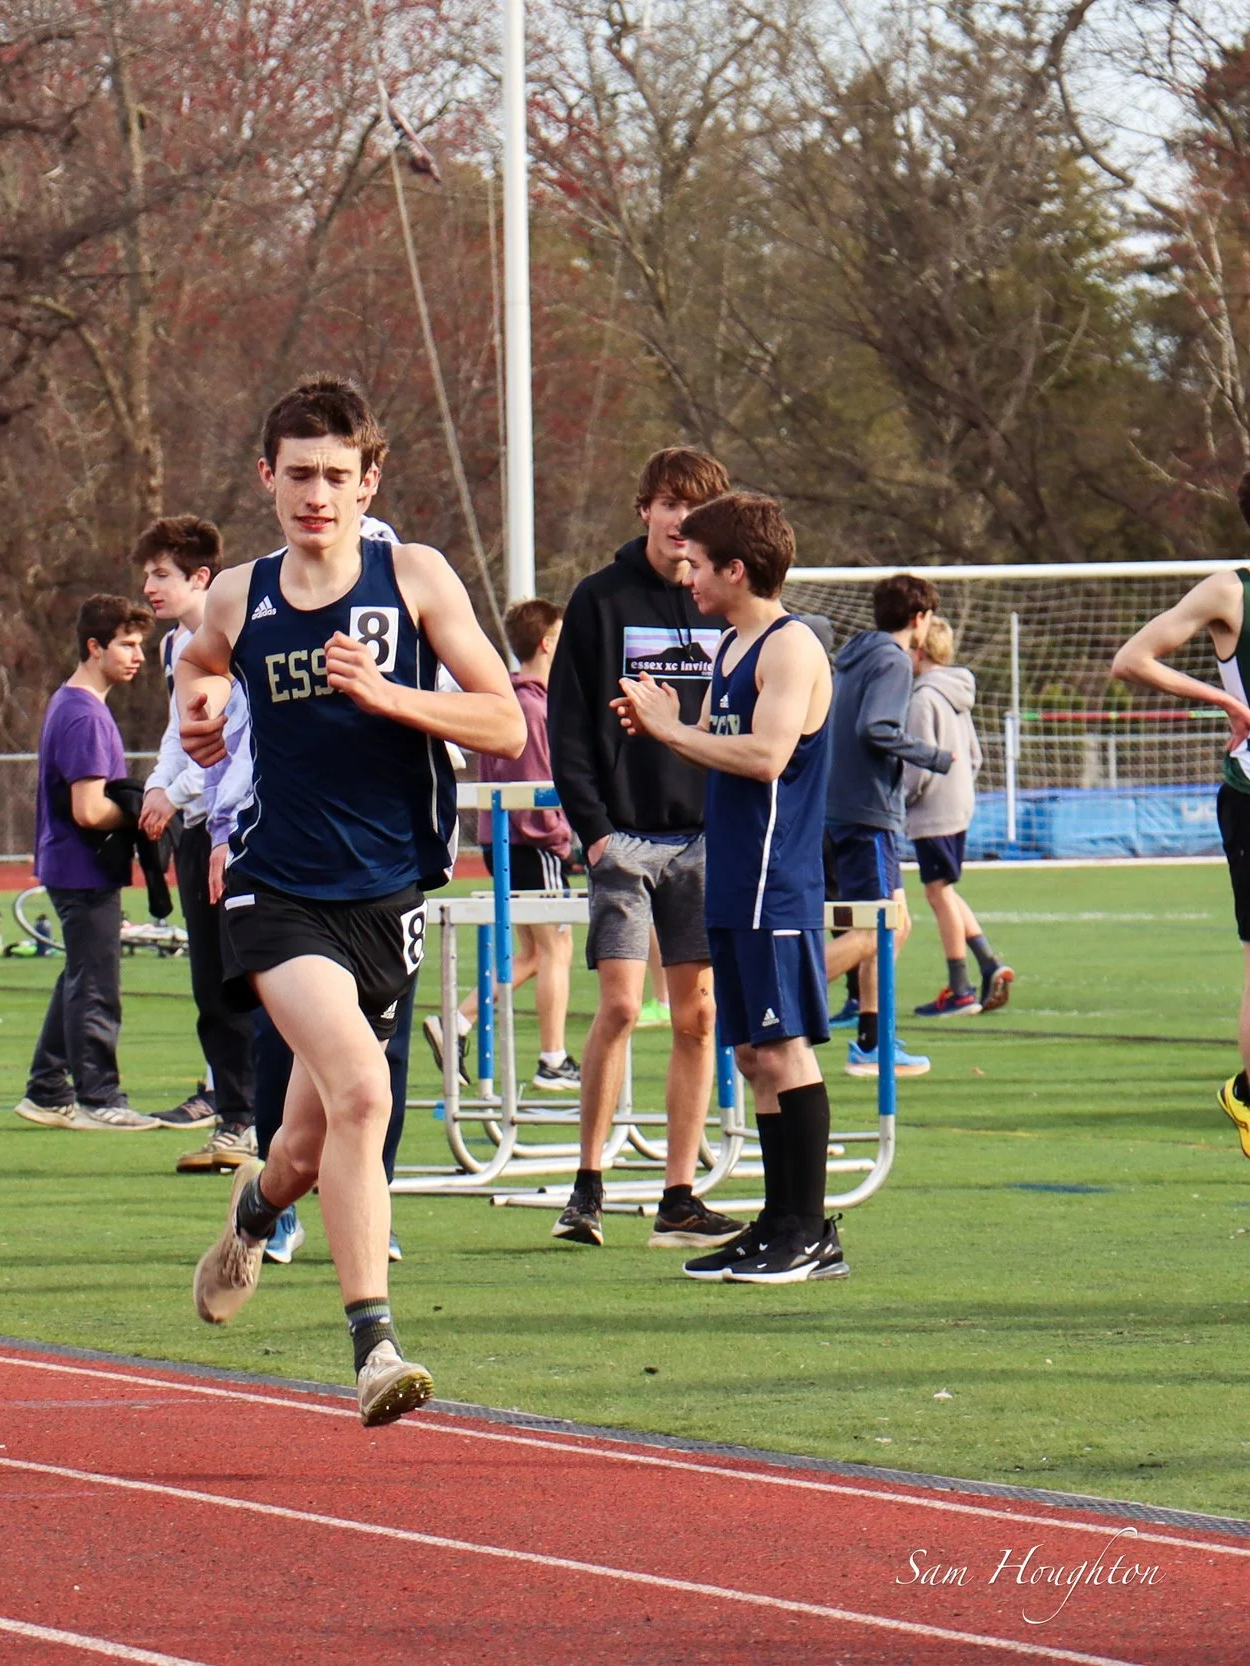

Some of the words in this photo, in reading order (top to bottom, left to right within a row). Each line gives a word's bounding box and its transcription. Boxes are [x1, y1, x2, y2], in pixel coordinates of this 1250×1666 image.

[357, 611, 390, 667] 8
[631, 660, 662, 670] essex
[664, 661, 678, 671] xc
[265, 648, 336, 703] ESS
[408, 911, 424, 964] 8
